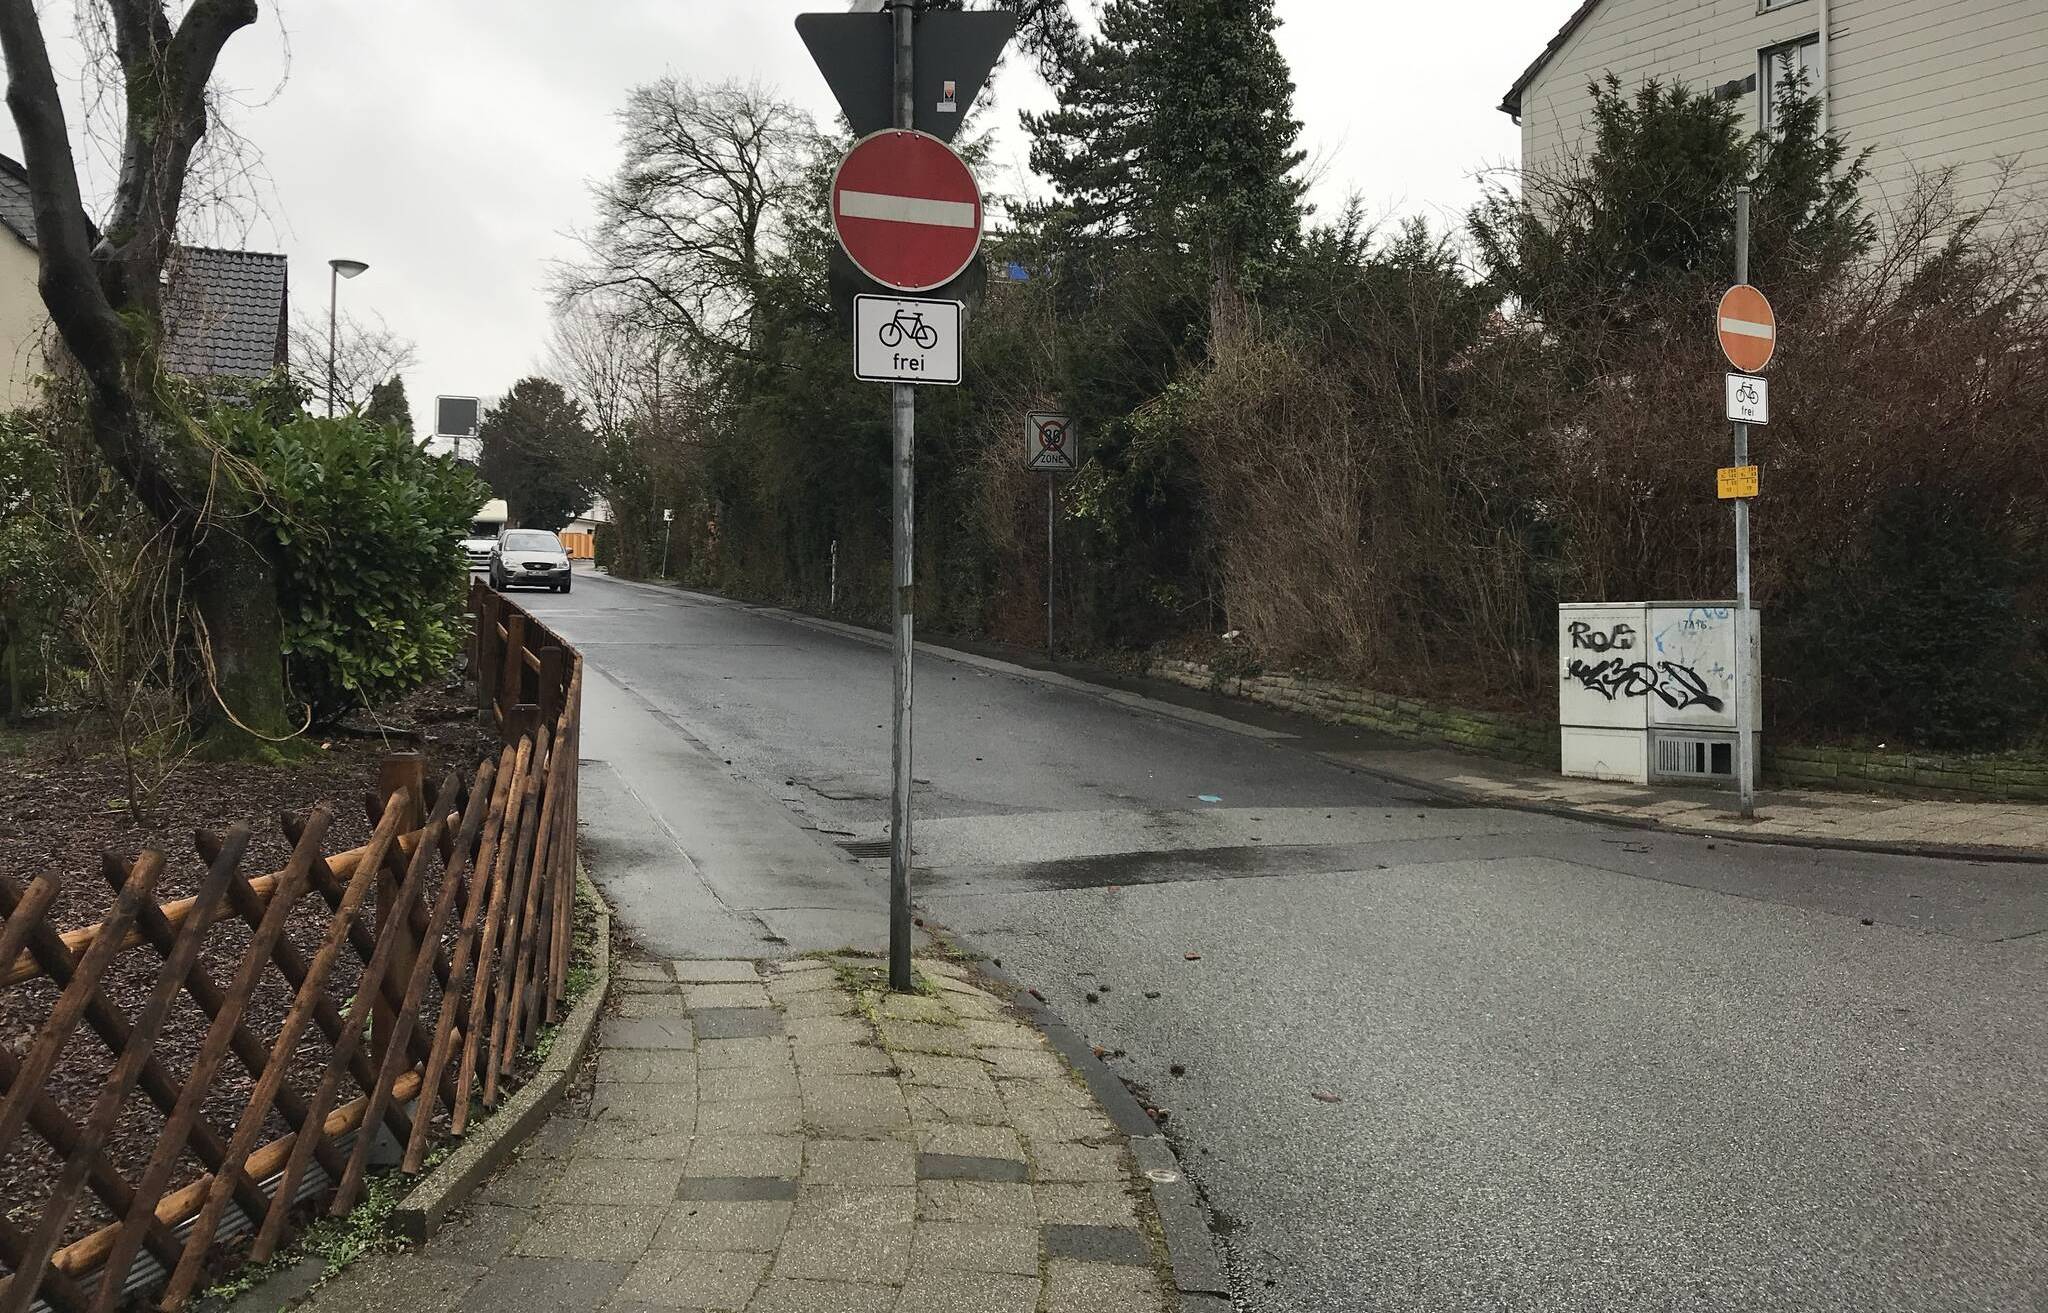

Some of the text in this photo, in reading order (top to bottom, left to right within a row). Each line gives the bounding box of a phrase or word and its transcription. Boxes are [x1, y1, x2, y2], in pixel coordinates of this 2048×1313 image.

[893, 353, 925, 371] frei
[1741, 405, 1755, 416] frei
[1040, 454, 1064, 464] ZONE
